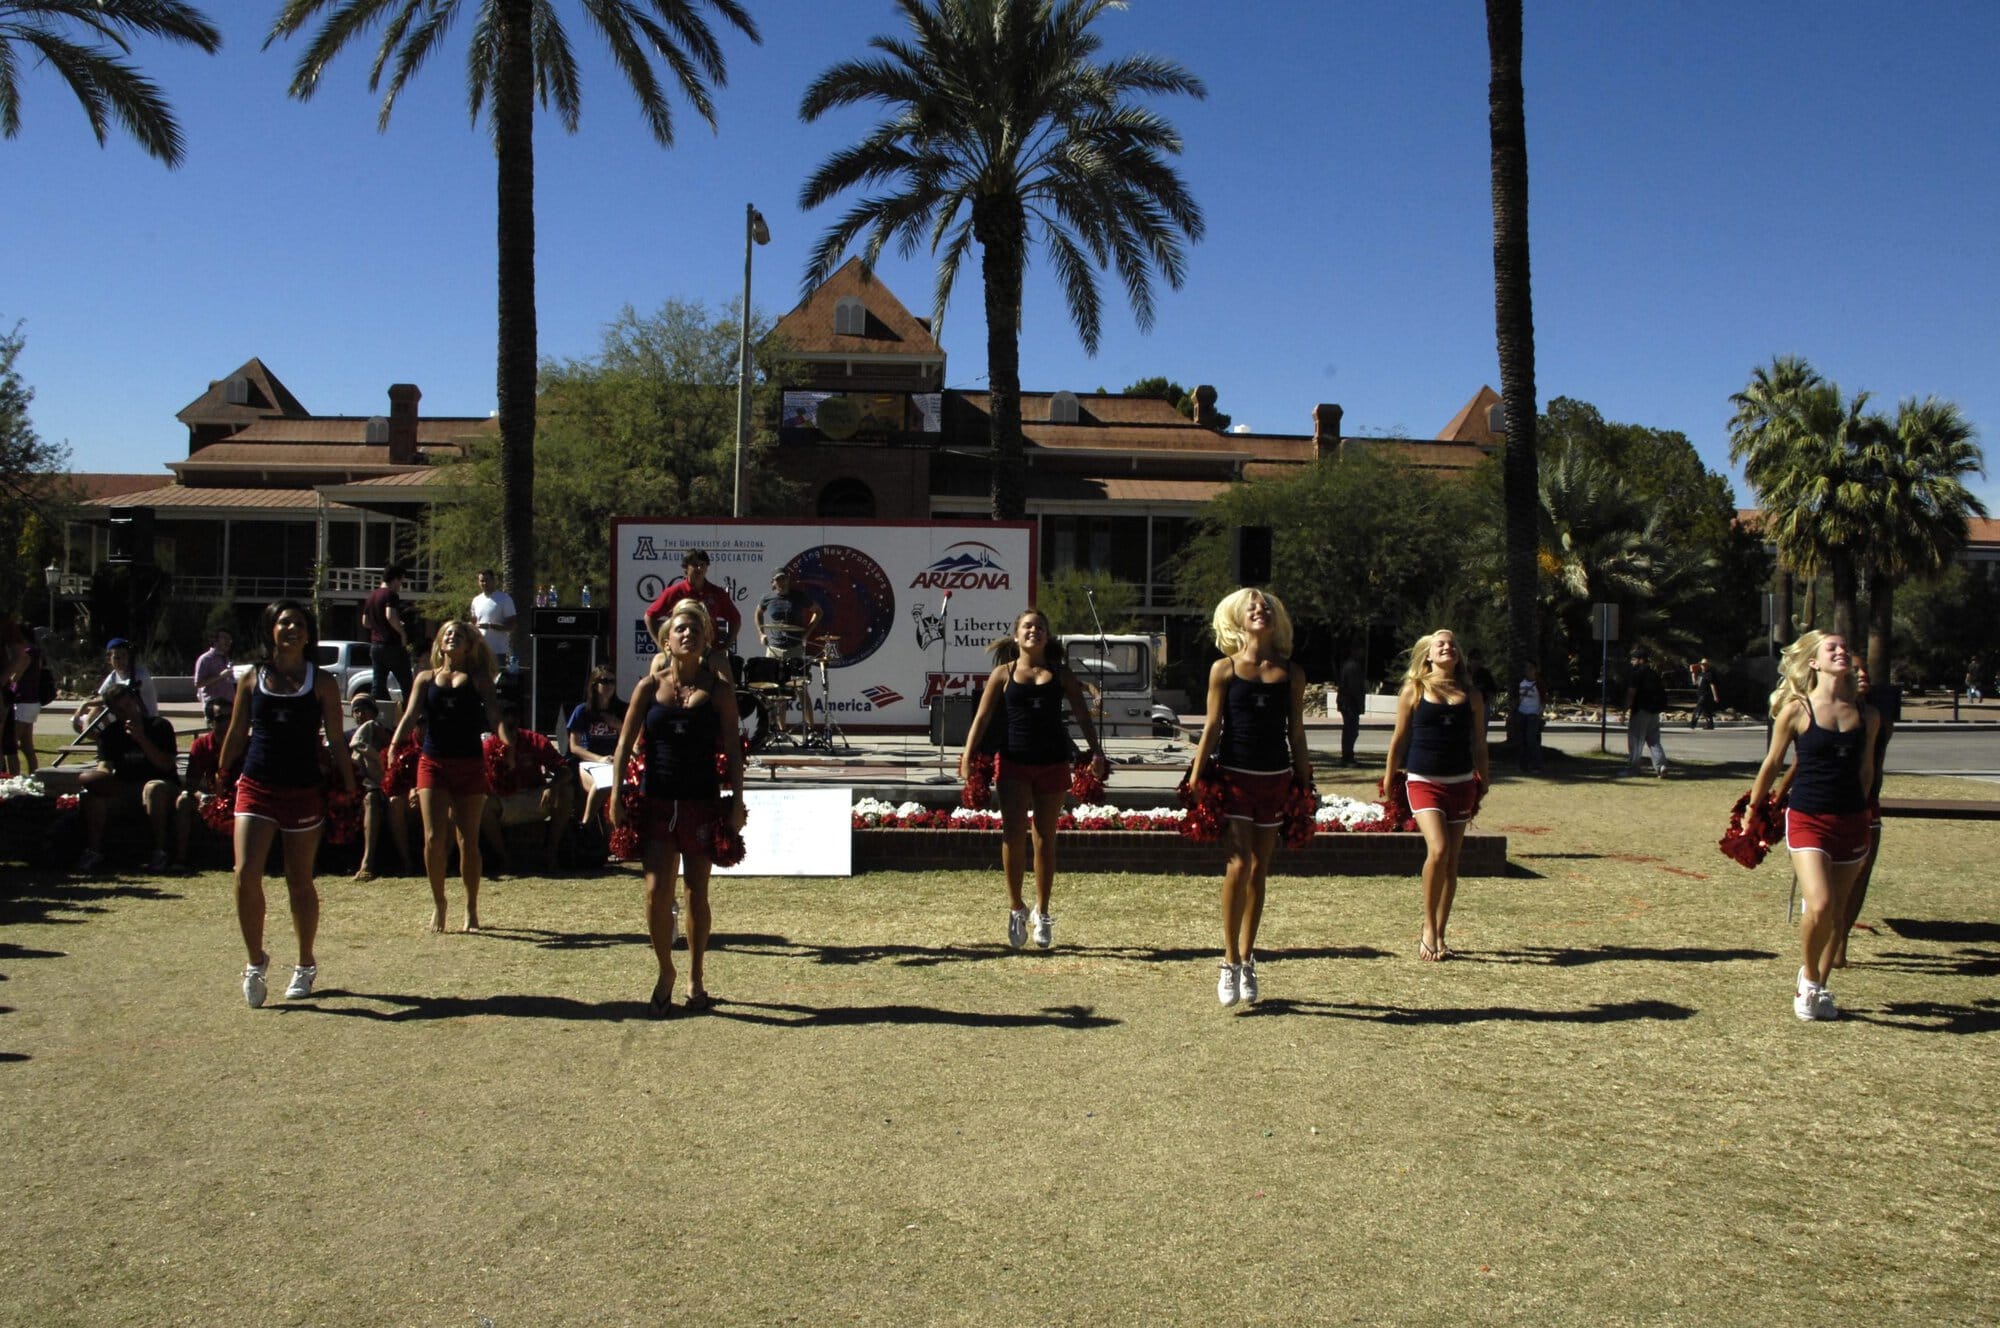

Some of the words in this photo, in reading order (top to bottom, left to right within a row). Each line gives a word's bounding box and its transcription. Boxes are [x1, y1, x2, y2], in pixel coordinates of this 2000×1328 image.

[679, 539, 720, 548] UNIVERSITY
[734, 539, 764, 548] ARIZONA
[708, 552, 764, 562] SSOCIATION
[908, 571, 1010, 590] ARIZONA
[953, 617, 1012, 635] Liberty
[813, 698, 872, 712] America
